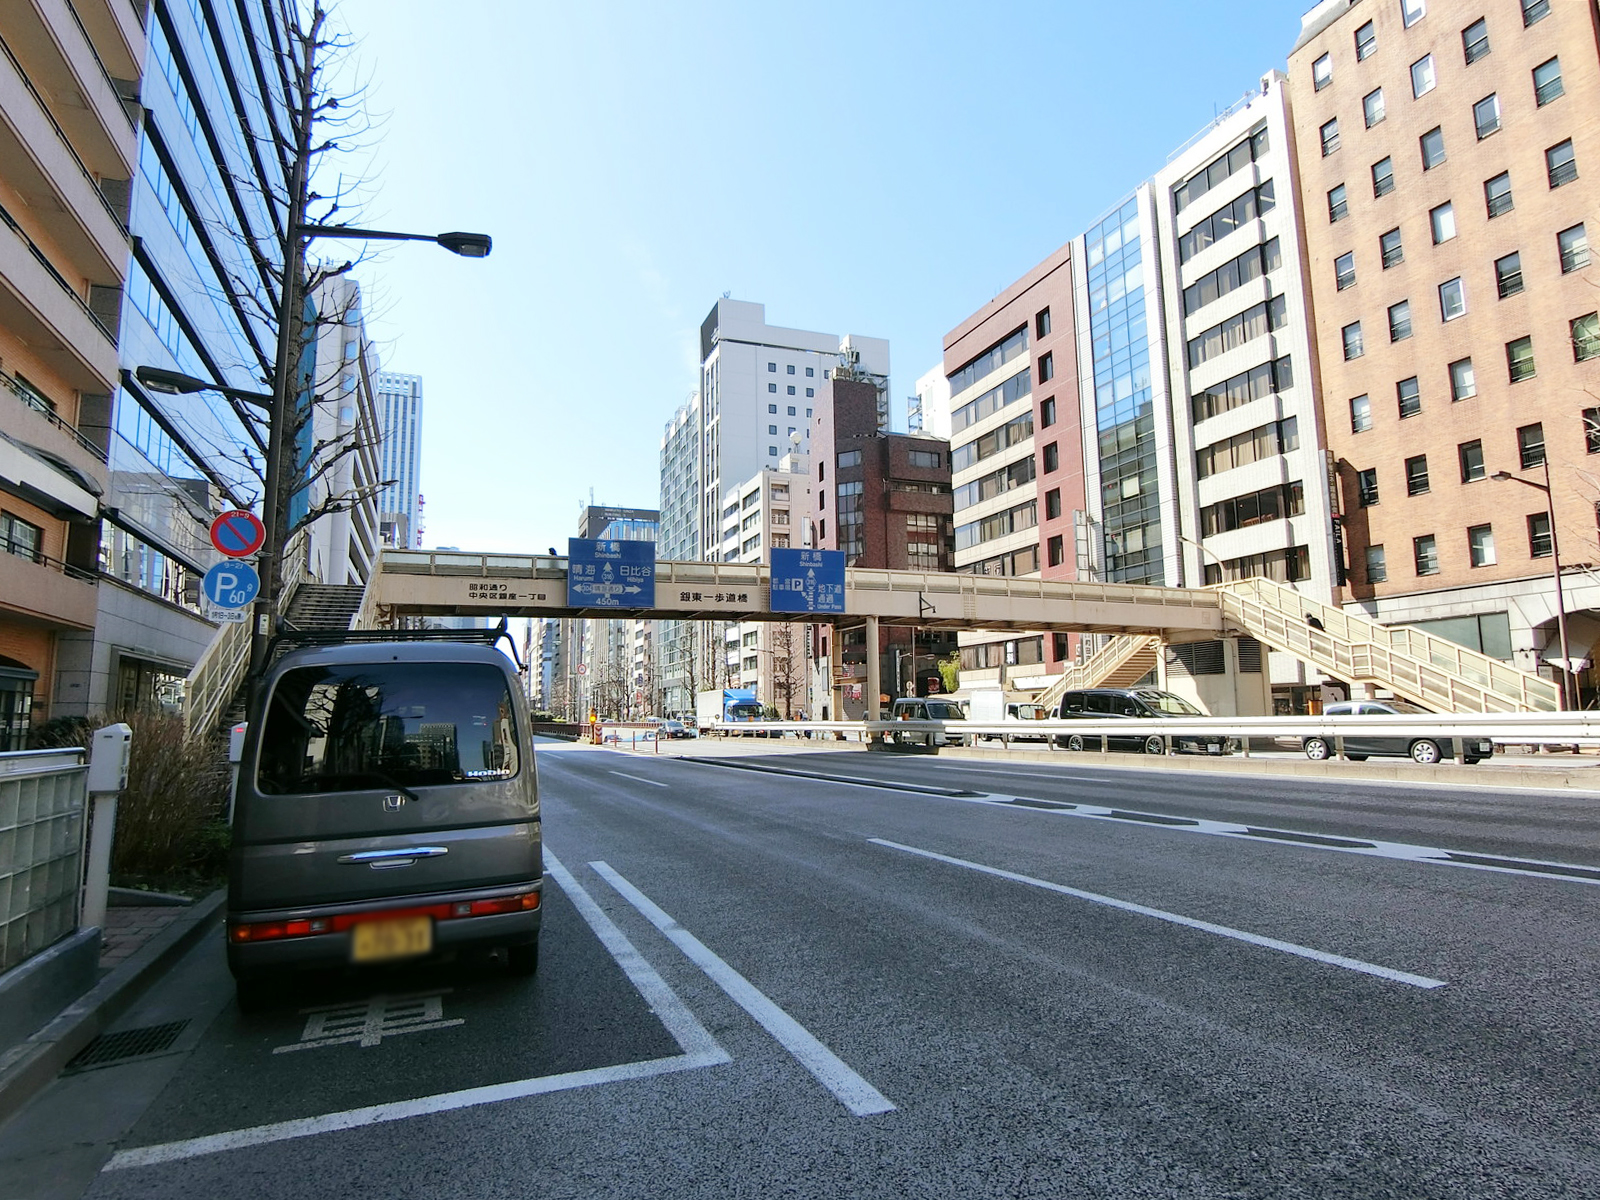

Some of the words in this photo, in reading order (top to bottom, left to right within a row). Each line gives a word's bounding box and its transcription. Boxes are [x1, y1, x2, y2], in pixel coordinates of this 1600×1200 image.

[596, 542, 620, 552] 新橋
[801, 551, 822, 561] 新橋
[572, 564, 595, 575] 晴海
[620, 565, 652, 577] 日比谷
[214, 572, 238, 602] P
[469, 583, 507, 591] 昭和通り
[818, 584, 841, 594] 地下道
[229, 590, 245, 604] 60
[468, 592, 547, 600] 中央区銀座一丁目
[680, 591, 748, 603] 銀東一歩道橋
[818, 594, 834, 603] 通過
